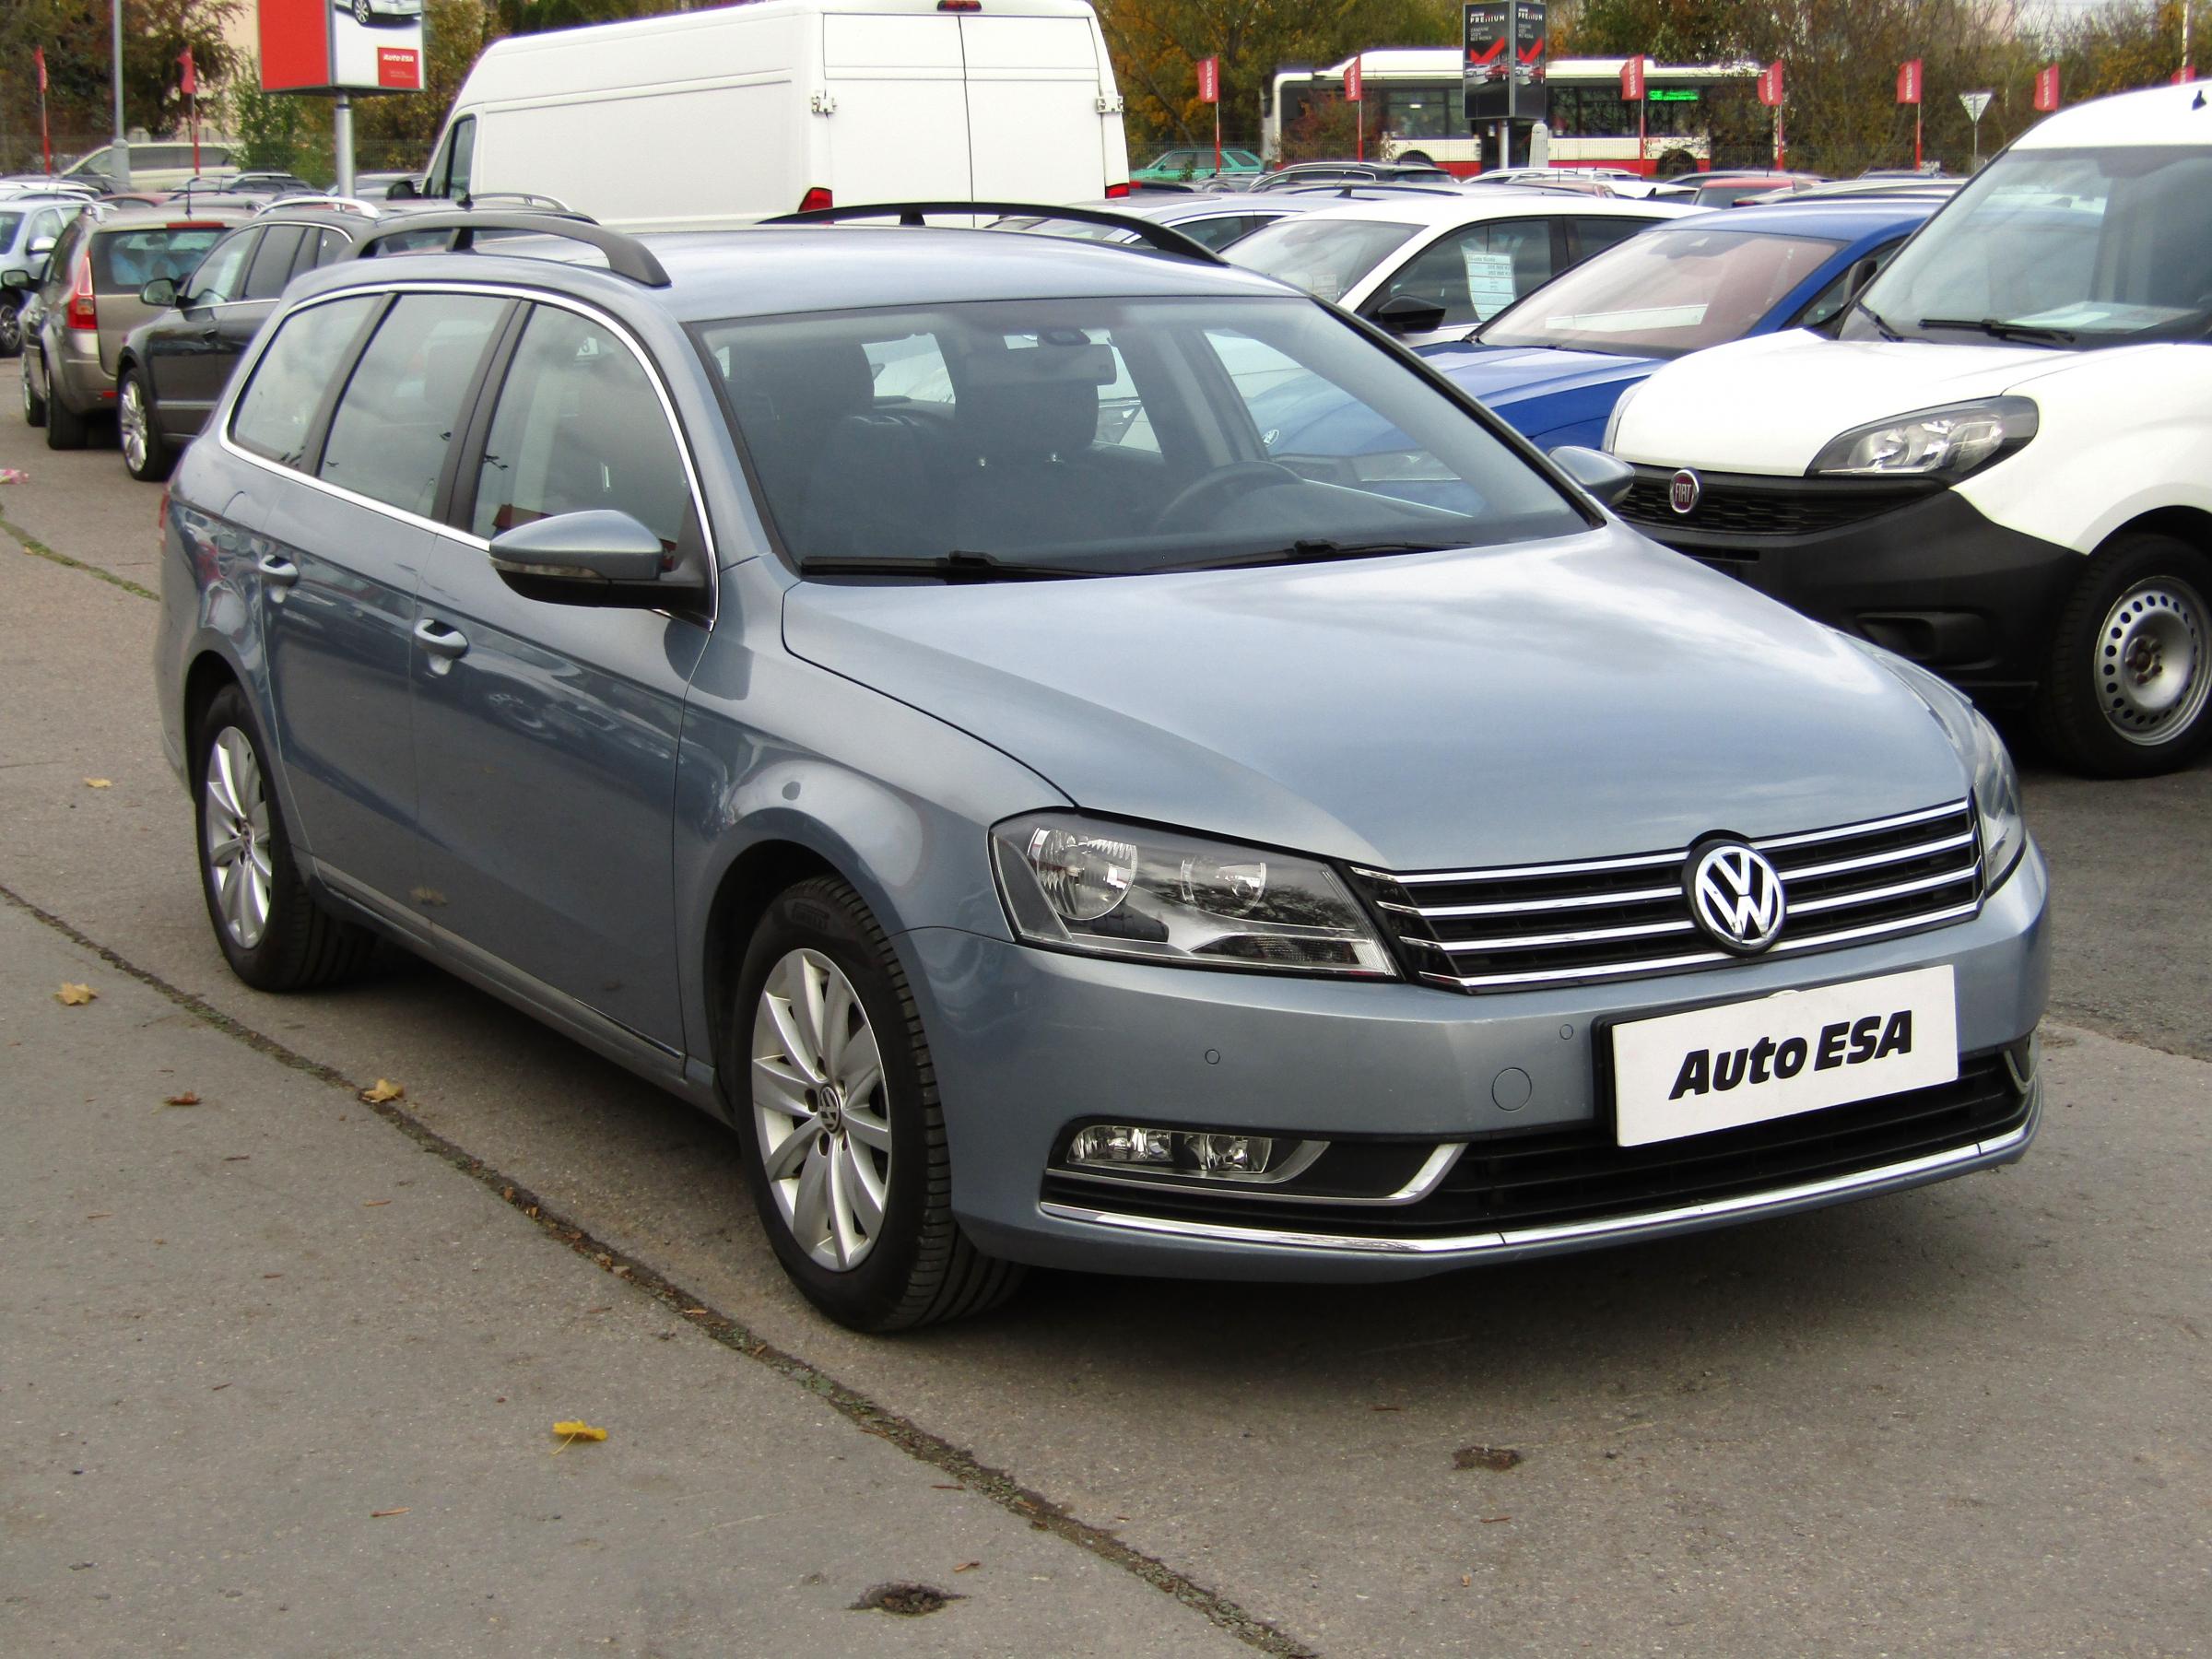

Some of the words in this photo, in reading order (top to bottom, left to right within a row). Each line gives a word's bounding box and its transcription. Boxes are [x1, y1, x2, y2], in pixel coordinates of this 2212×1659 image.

[1470, 15, 1505, 23] PREMIUM
[1675, 483, 1692, 503] FIAT
[1694, 844, 1785, 946] VW
[1669, 1037, 1808, 1100] Auto
[1814, 1010, 1912, 1071] ESA
